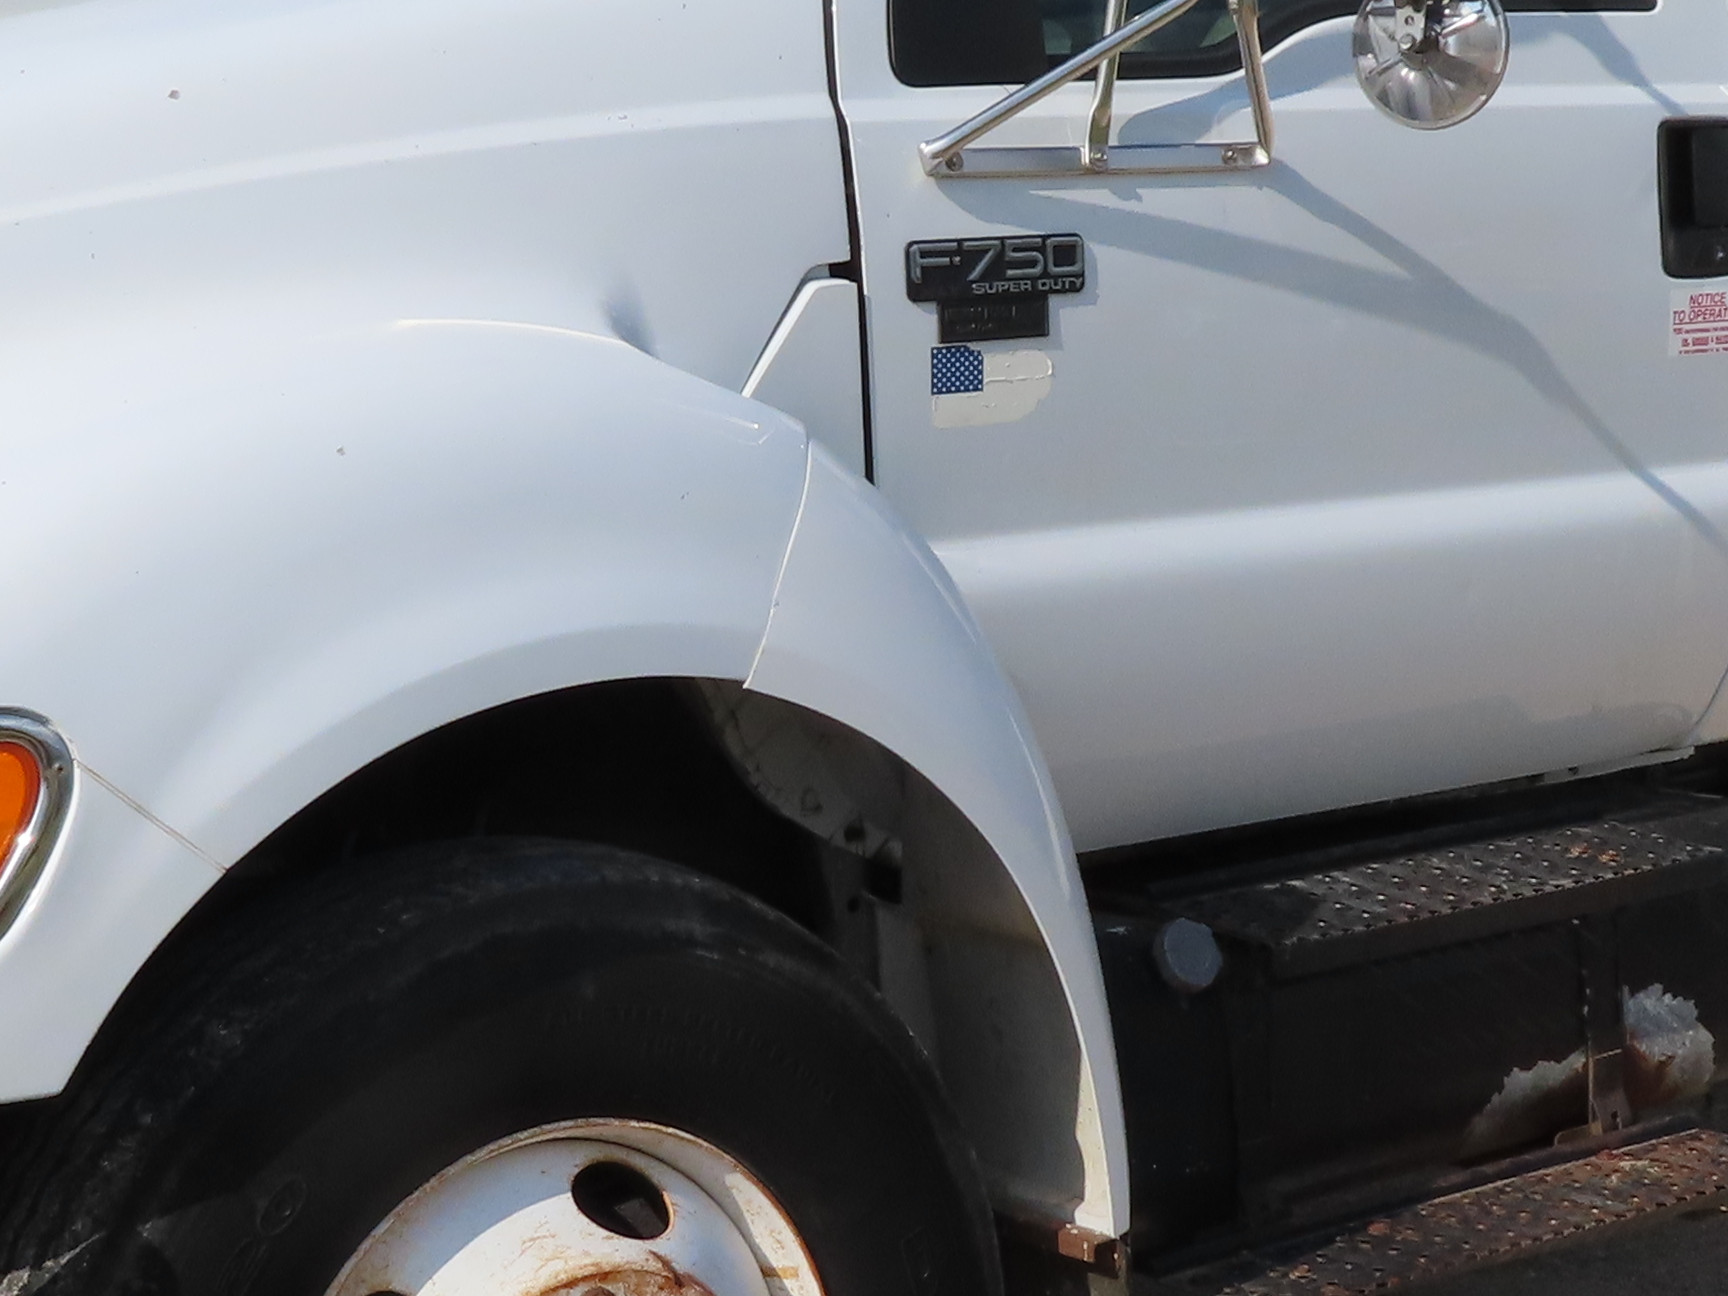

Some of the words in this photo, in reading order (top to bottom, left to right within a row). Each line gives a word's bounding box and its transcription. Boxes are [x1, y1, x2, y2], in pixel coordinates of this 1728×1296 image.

[972, 279, 1032, 295] SUPER
[1038, 277, 1083, 291] DUTY
[1689, 292, 1727, 307] NOTICE
[1673, 309, 1686, 323] TO
